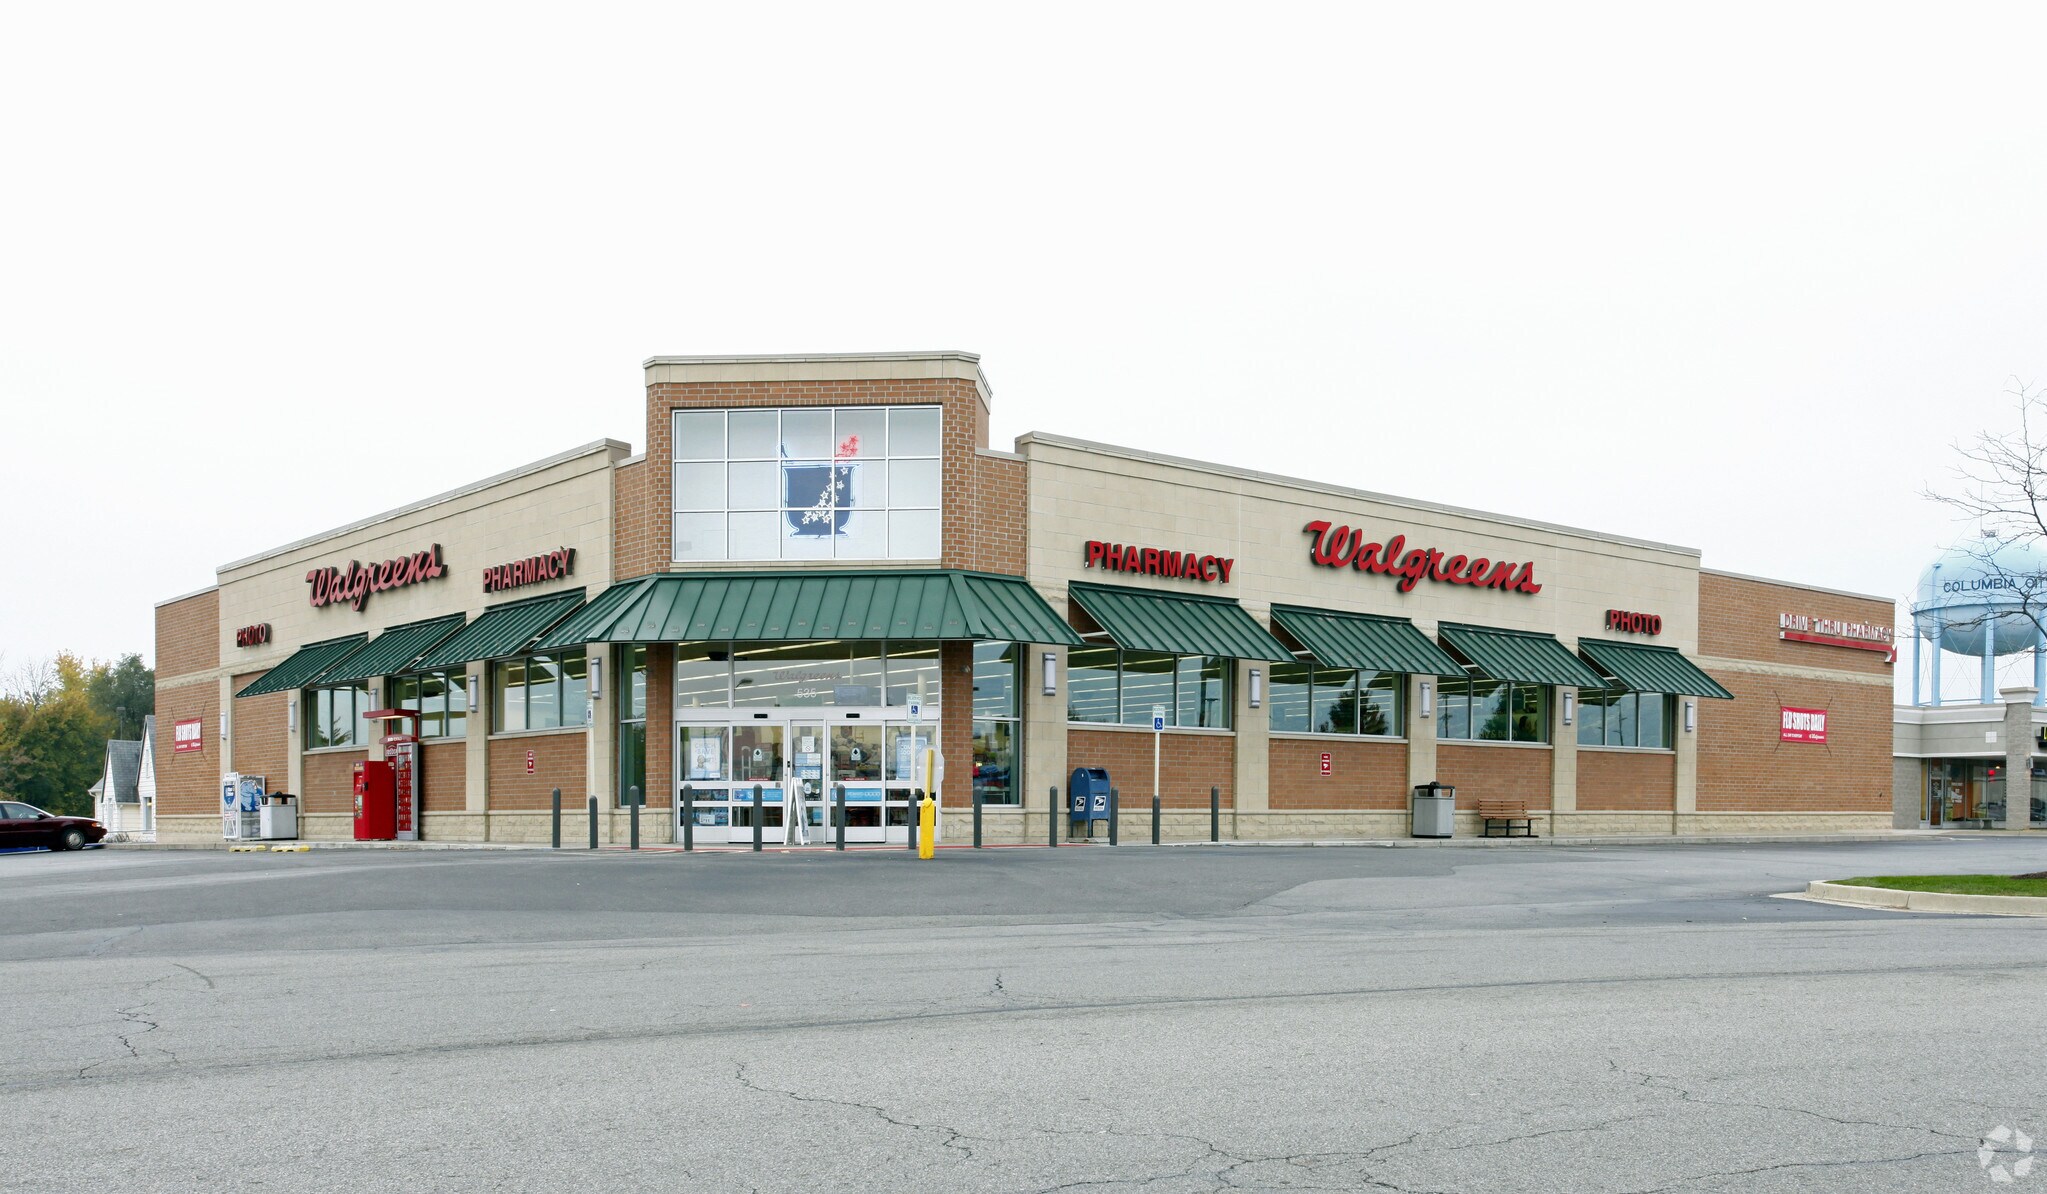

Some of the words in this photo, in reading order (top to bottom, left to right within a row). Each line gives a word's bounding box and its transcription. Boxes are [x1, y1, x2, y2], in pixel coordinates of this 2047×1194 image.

[305, 543, 447, 612] Walgreens
[483, 548, 576, 593] PHARMACY
[1085, 540, 1234, 584] PHARMACY
[1304, 520, 1542, 594] Walgreens
[1943, 578, 2016, 593] COLUMBIA
[237, 623, 270, 647] PHOTO
[1605, 609, 1662, 635] PHOTO
